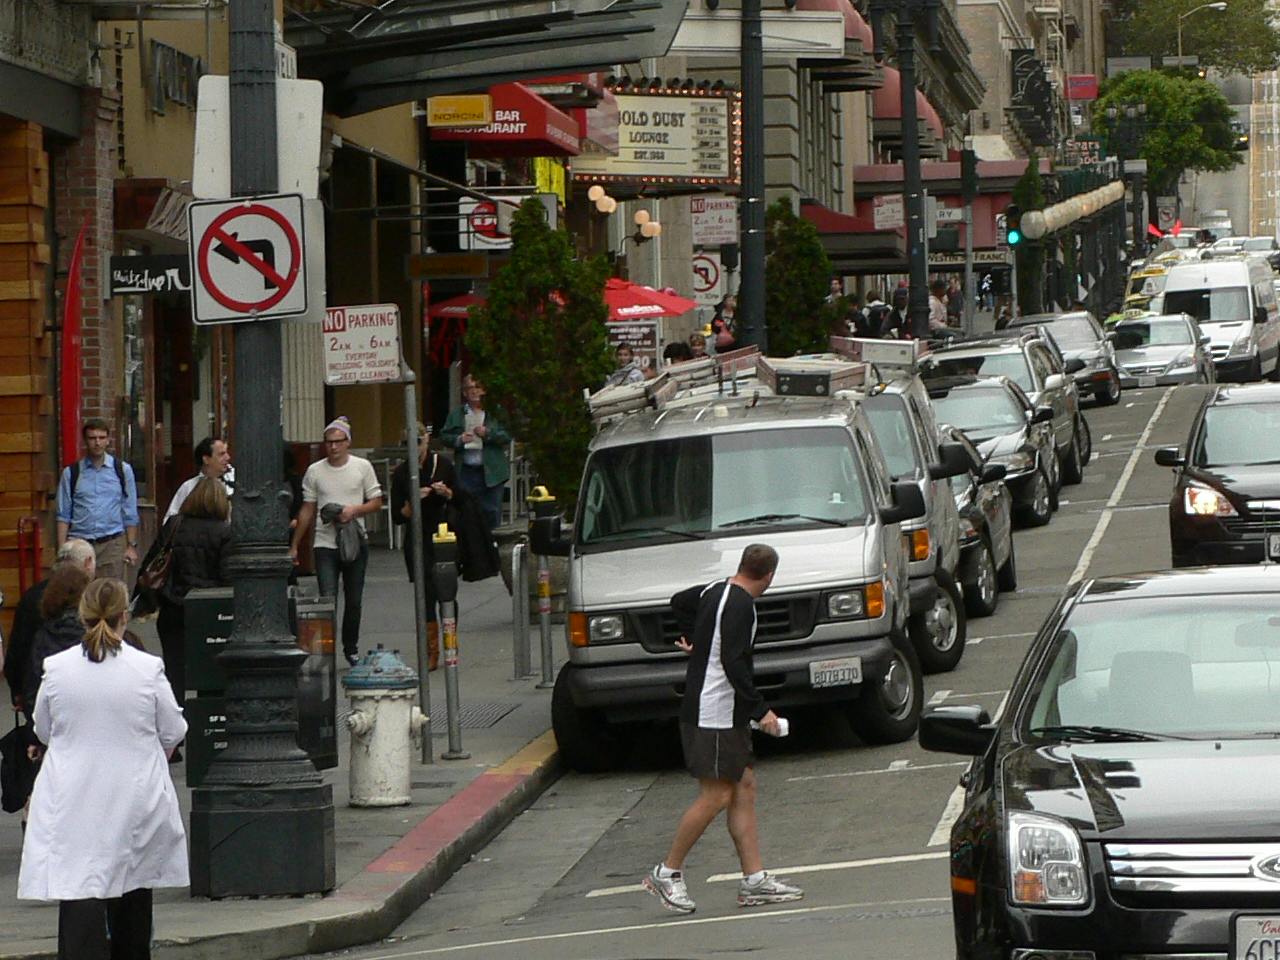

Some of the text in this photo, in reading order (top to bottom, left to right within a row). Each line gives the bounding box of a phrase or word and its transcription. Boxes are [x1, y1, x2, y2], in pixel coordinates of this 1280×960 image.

[495, 110, 520, 121] BAR
[618, 111, 648, 127] OLD
[629, 131, 669, 145] LOUNGE
[324, 310, 395, 331] NO PARKING
